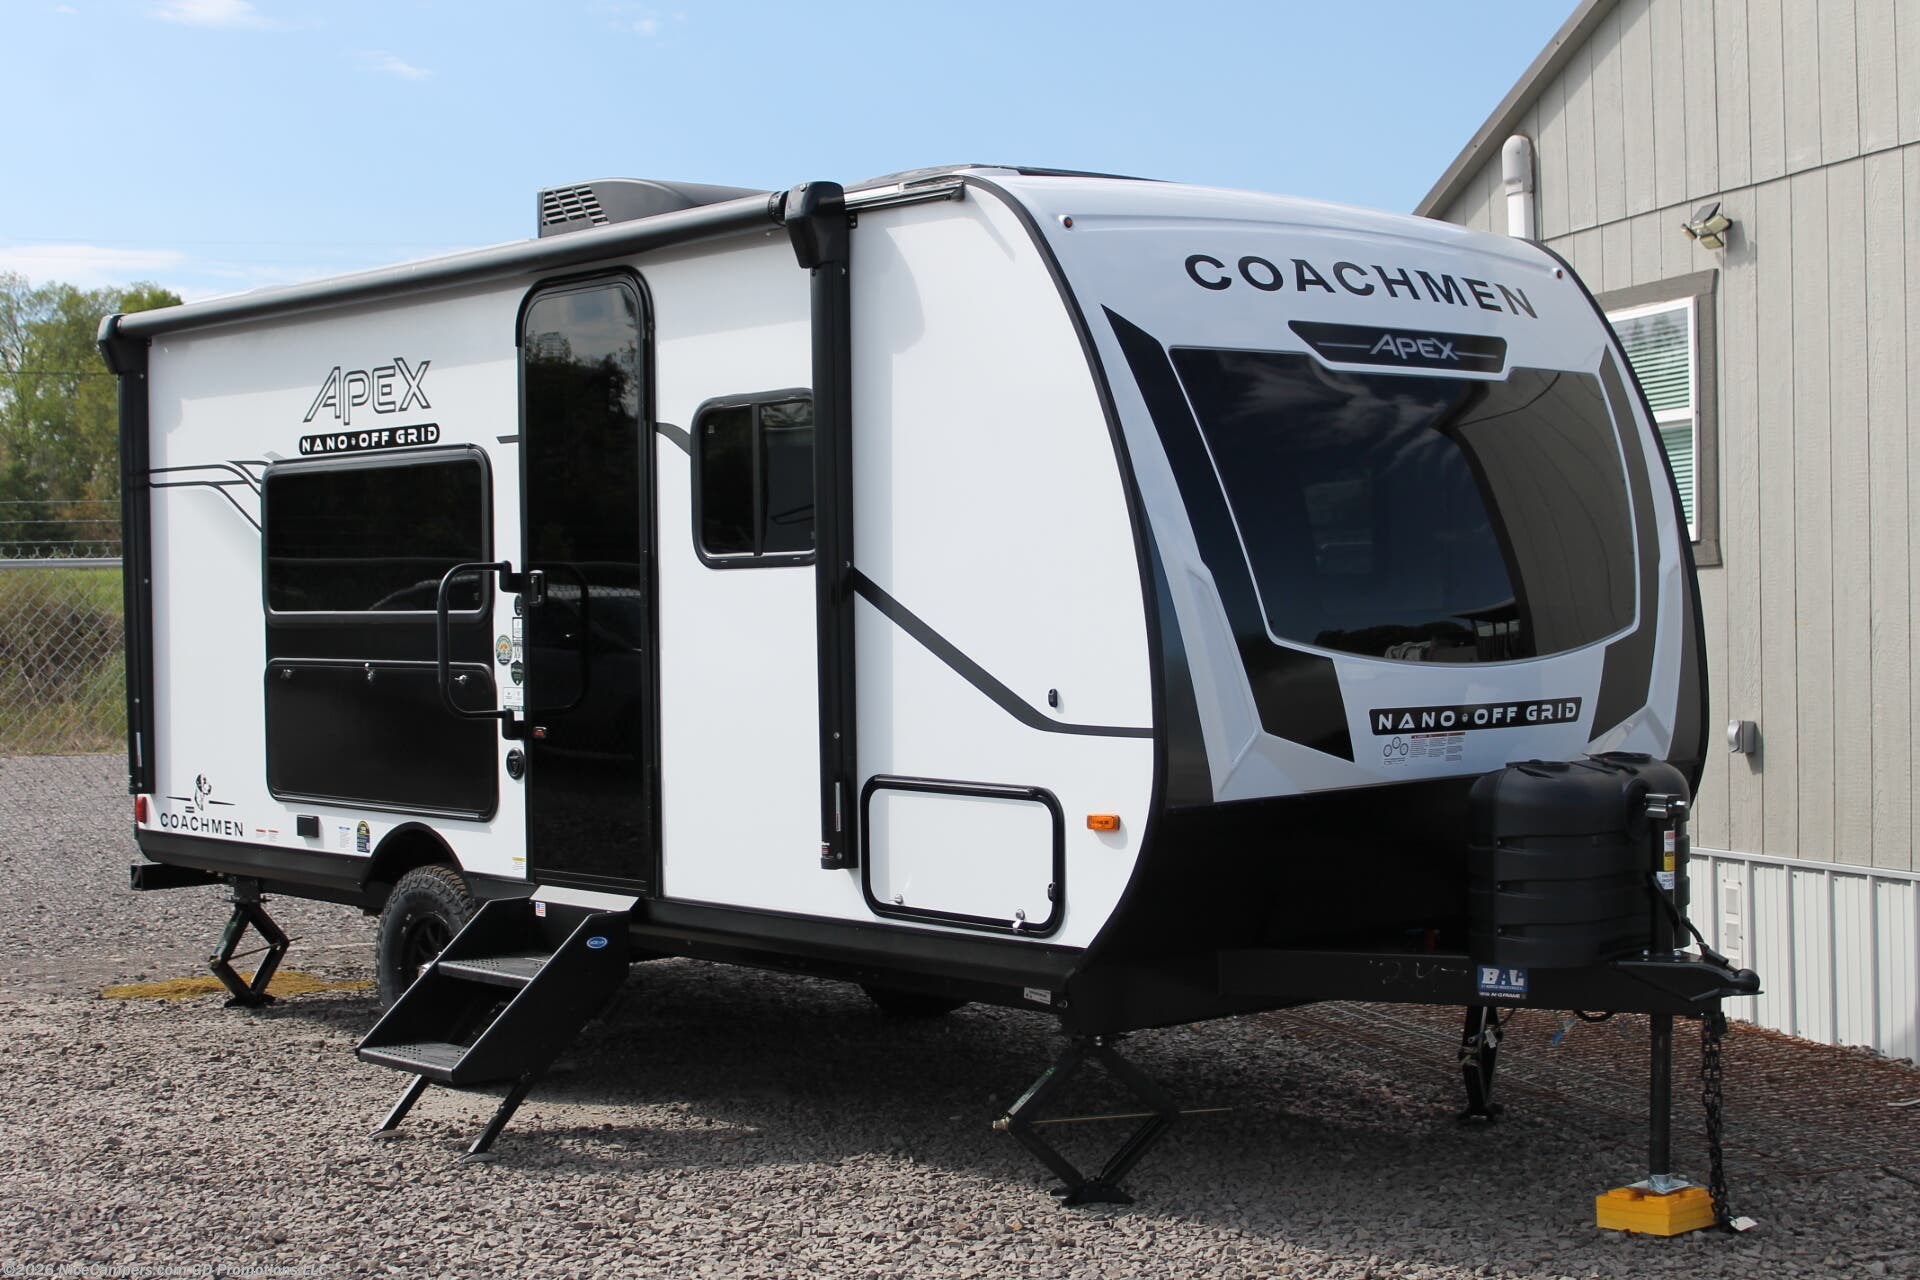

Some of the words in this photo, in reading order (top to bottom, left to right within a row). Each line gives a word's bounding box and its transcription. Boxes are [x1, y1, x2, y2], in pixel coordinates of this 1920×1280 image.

[1184, 254, 1539, 319] COACHMEN
[1370, 334, 1459, 360] APEX
[302, 357, 432, 426] APEX
[302, 435, 348, 452] NANO
[359, 431, 390, 447] OFF
[396, 426, 437, 444] GRID
[1378, 710, 1456, 730] NANO
[1474, 706, 1518, 724] OFF
[1526, 702, 1577, 721] GRID
[160, 812, 243, 837] COACHMEN
